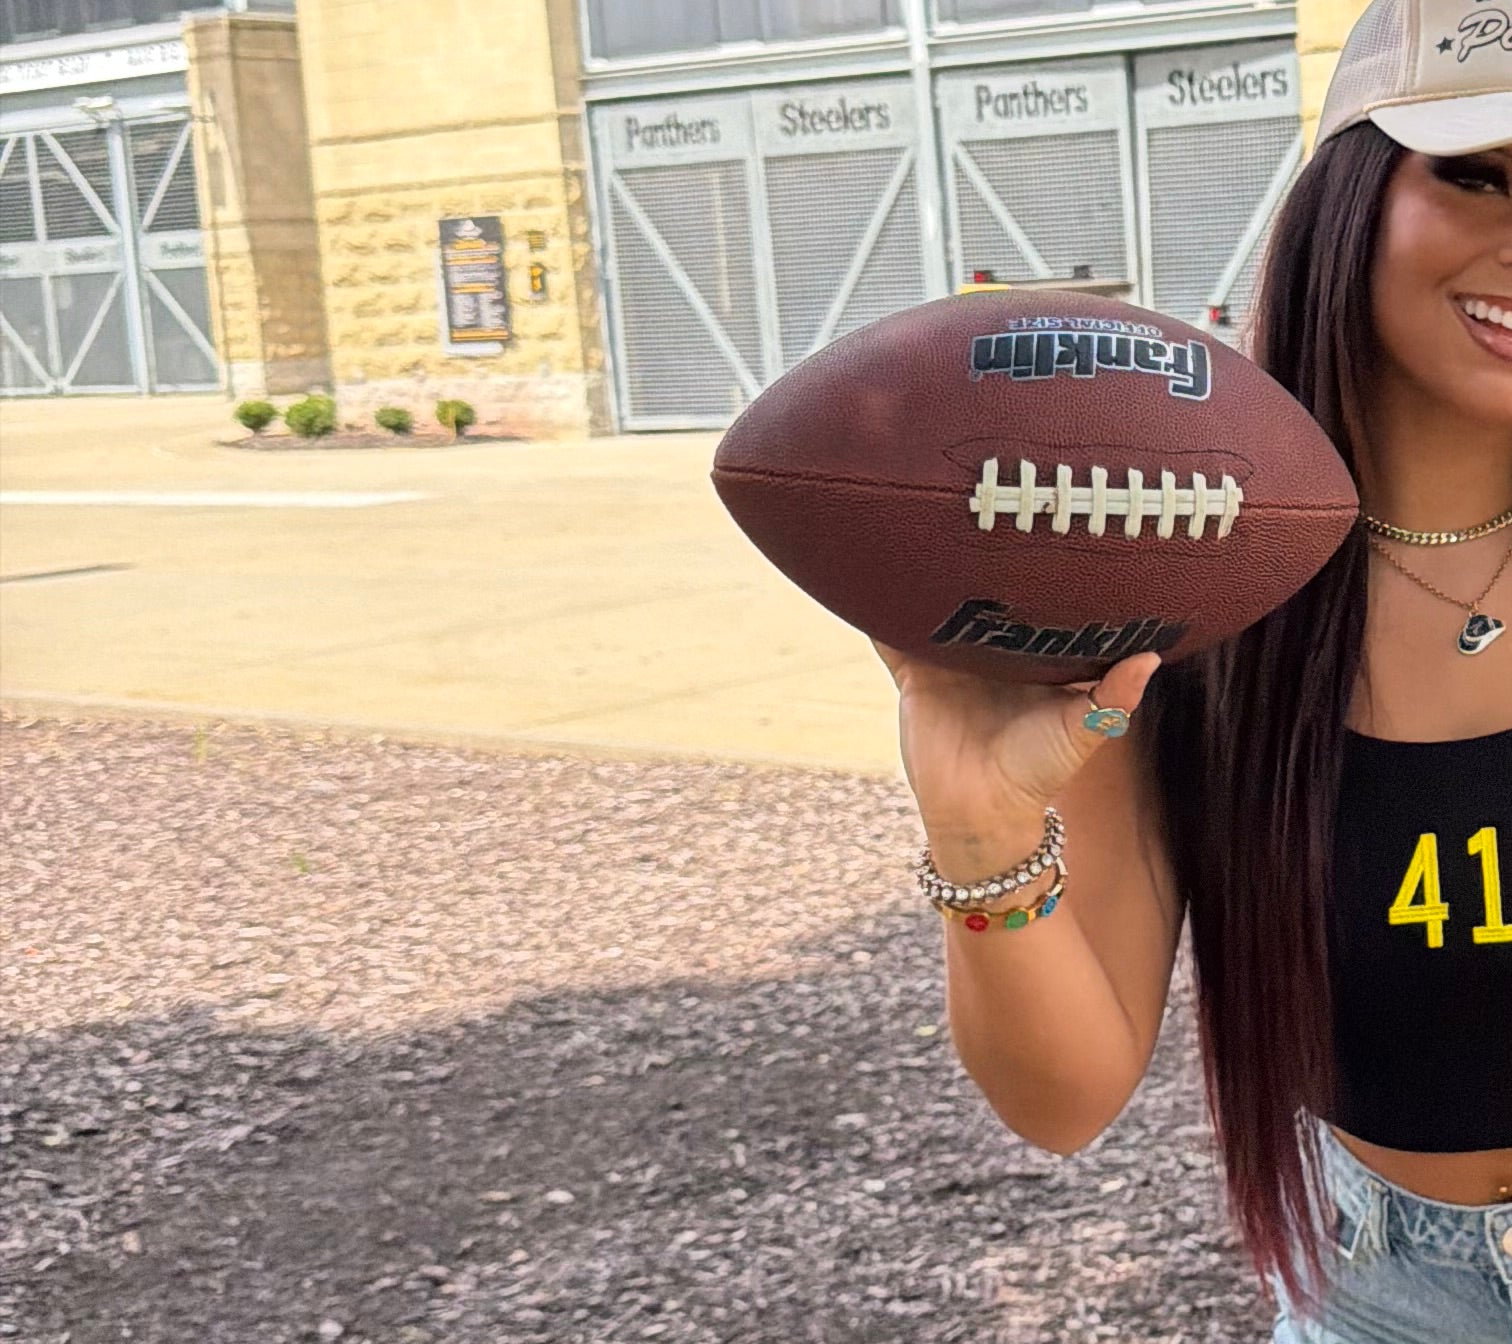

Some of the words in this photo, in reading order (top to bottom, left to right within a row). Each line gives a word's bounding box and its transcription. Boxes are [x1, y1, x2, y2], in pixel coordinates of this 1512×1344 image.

[779, 96, 891, 137] Steelers
[974, 80, 1088, 122] Panthers
[1168, 61, 1288, 105] Steelers
[1069, 319, 1163, 338] OFFICIAL
[970, 330, 1212, 400] Franklin
